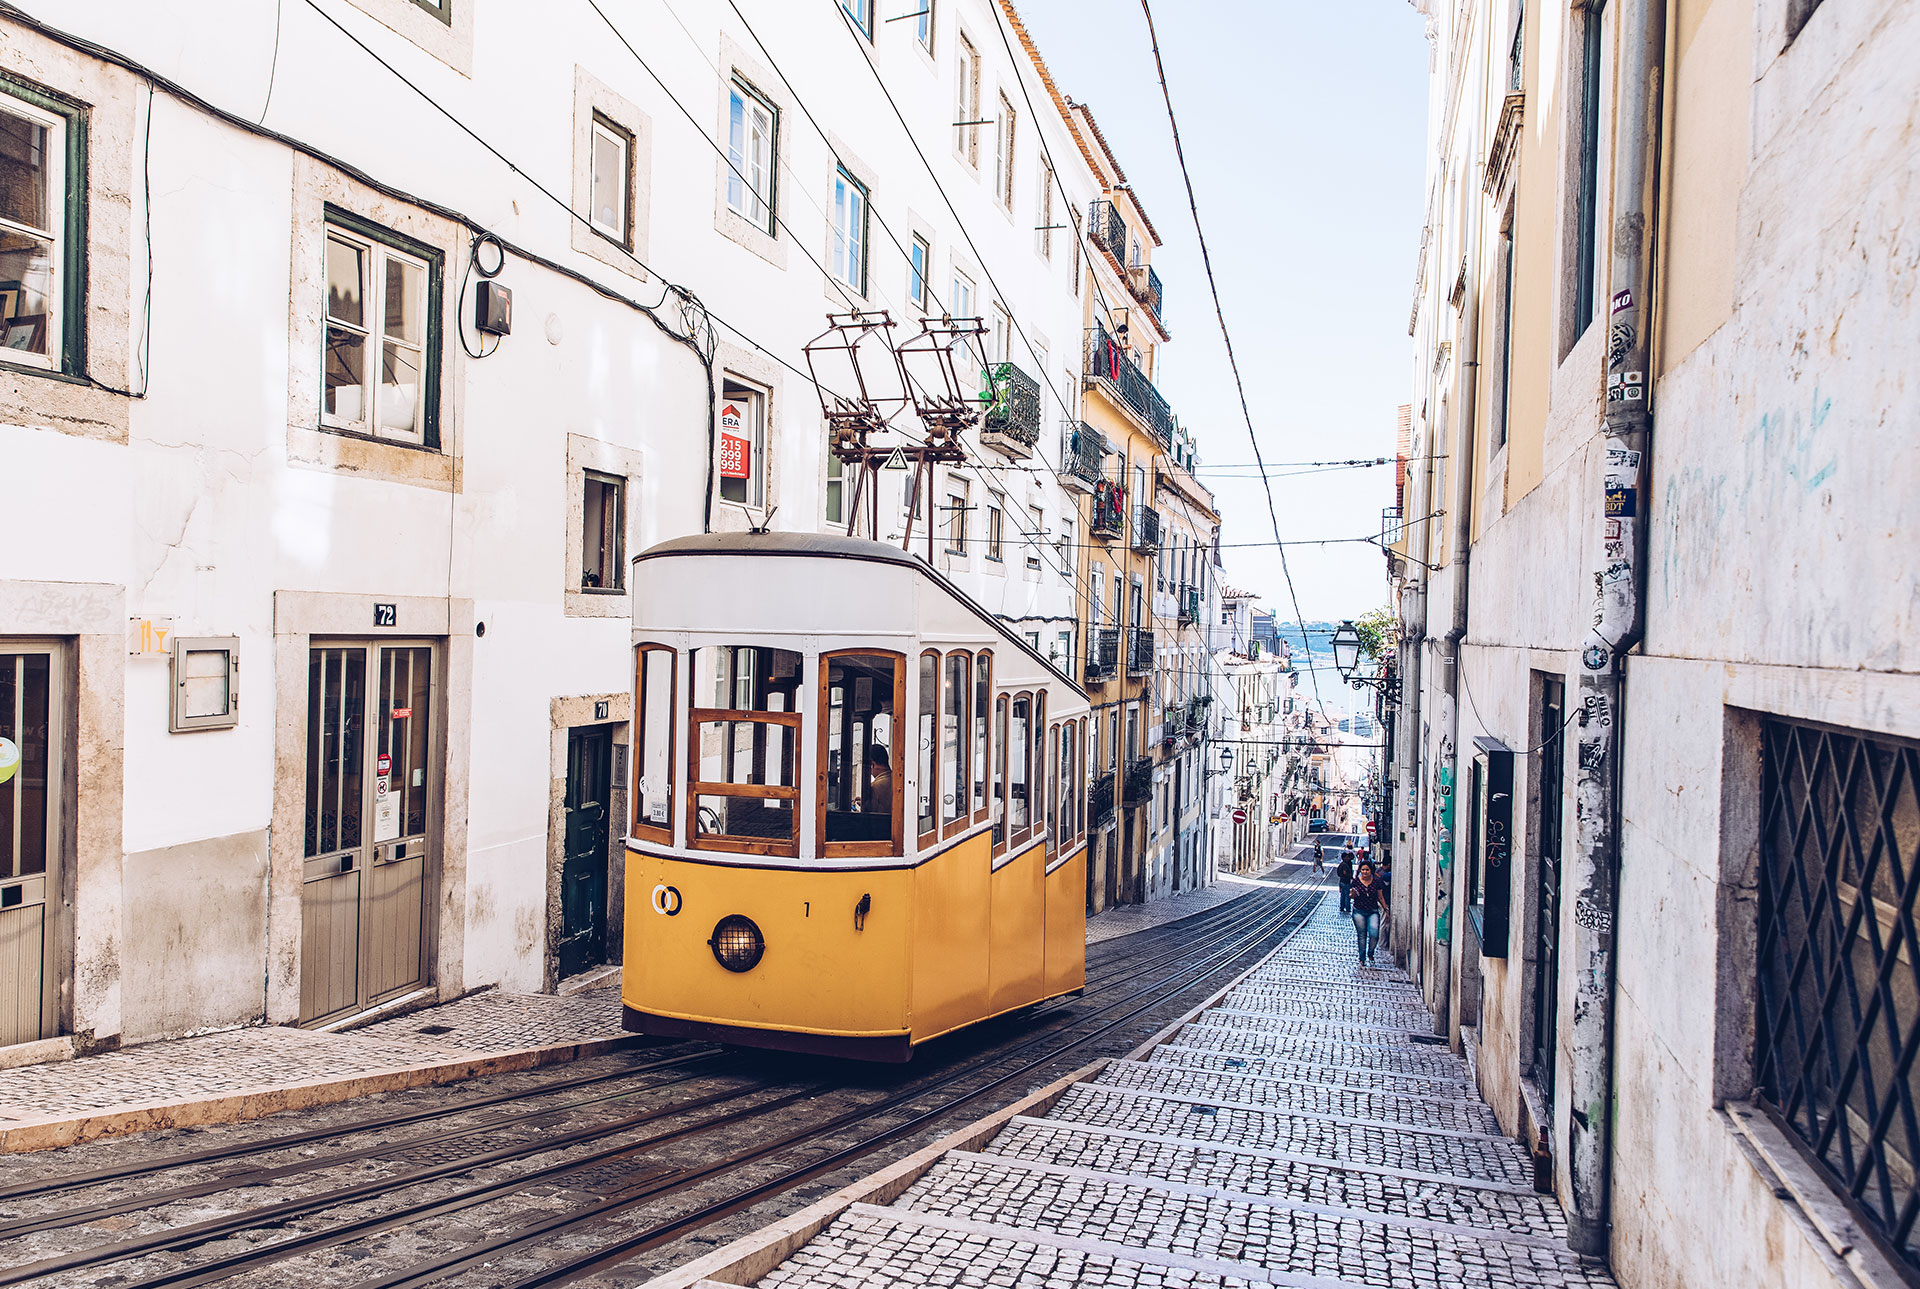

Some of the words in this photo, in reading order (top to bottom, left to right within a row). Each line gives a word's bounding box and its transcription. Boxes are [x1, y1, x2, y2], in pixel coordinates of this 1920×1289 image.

[722, 417, 740, 427] ERA
[721, 439, 742, 451] 215
[721, 449, 742, 461] 999
[721, 459, 742, 471] 995
[378, 605, 394, 625] 72
[598, 703, 608, 718] 70
[803, 901, 810, 918] 1
